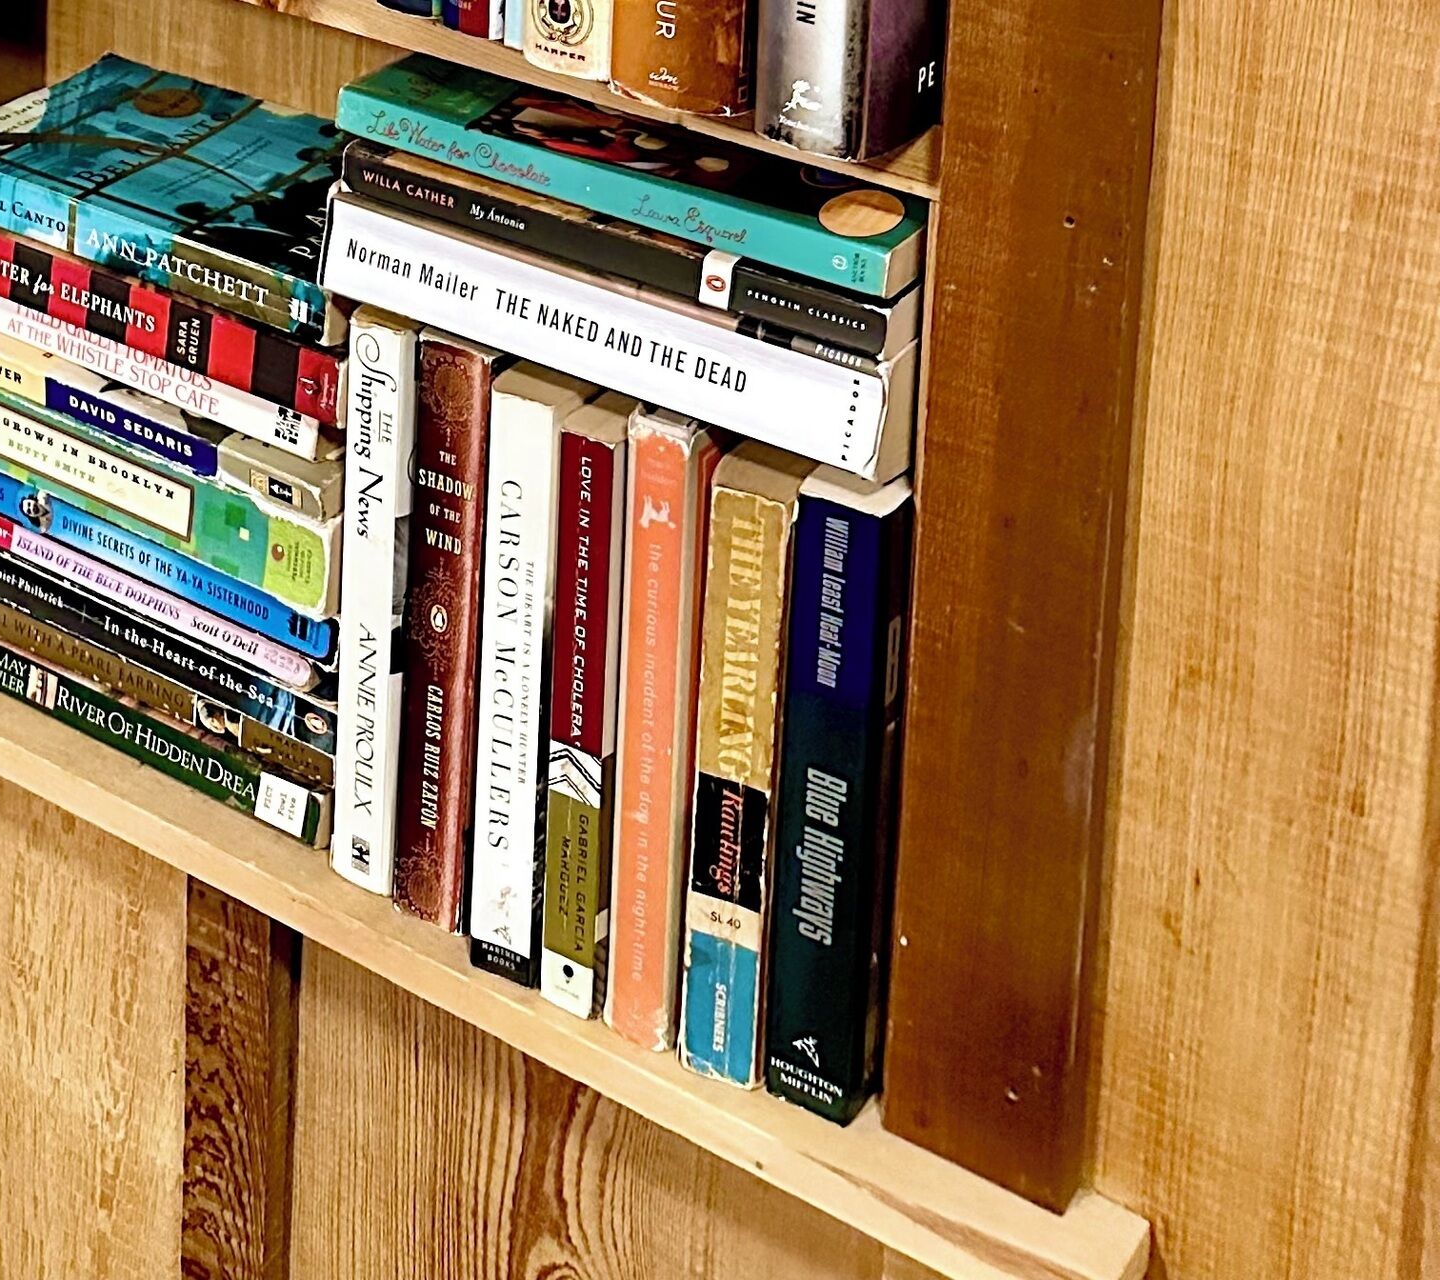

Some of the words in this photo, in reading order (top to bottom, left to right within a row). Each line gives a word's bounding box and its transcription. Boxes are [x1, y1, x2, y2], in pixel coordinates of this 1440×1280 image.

[361, 168, 402, 193] WILLA
[405, 183, 456, 210] CATHER
[85, 227, 139, 265] ANN
[142, 246, 271, 308] PATCHETT
[346, 237, 412, 280] Norman
[418, 262, 480, 302] Mailer
[32, 272, 56, 297] for
[59, 281, 157, 334] ELEPHANTS
[746, 288, 801, 312] PENGUIN
[807, 306, 867, 332] CLASSICS
[176, 319, 190, 356] SARA
[187, 316, 202, 365] GRUEN
[494, 287, 531, 321] THE
[535, 302, 600, 344] NAKED
[604, 326, 643, 358] AND
[649, 340, 688, 374] THE
[694, 355, 748, 394] DEAD
[67, 394, 118, 425] DAVID
[122, 418, 194, 458] SEDARIS
[840, 378, 861, 462] PICADOR
[2, 417, 55, 447] GROWS
[61, 443, 80, 459] IN
[87, 454, 176, 500] BROOKLYN
[439, 449, 458, 467] THE
[579, 455, 593, 503] LOVE
[418, 467, 475, 503] SHADOW
[429, 502, 441, 518] OF
[443, 506, 462, 525] THE
[579, 507, 591, 529] IN
[425, 527, 462, 556] WIND
[496, 479, 523, 624] CARSON
[577, 535, 590, 572] THE
[575, 575, 588, 621] TIME
[574, 624, 586, 651] OF
[425, 684, 445, 741] CARLOS
[570, 655, 586, 740] CHOLERA
[422, 742, 441, 780] RUIZ
[486, 639, 518, 852] McCULLERS
[419, 780, 439, 830] ZAFÓN
[804, 766, 849, 828] Blue
[791, 824, 846, 947] Highways
[769, 1055, 844, 1099] HOUGHTON
[778, 1071, 835, 1106] MIFFLIN
